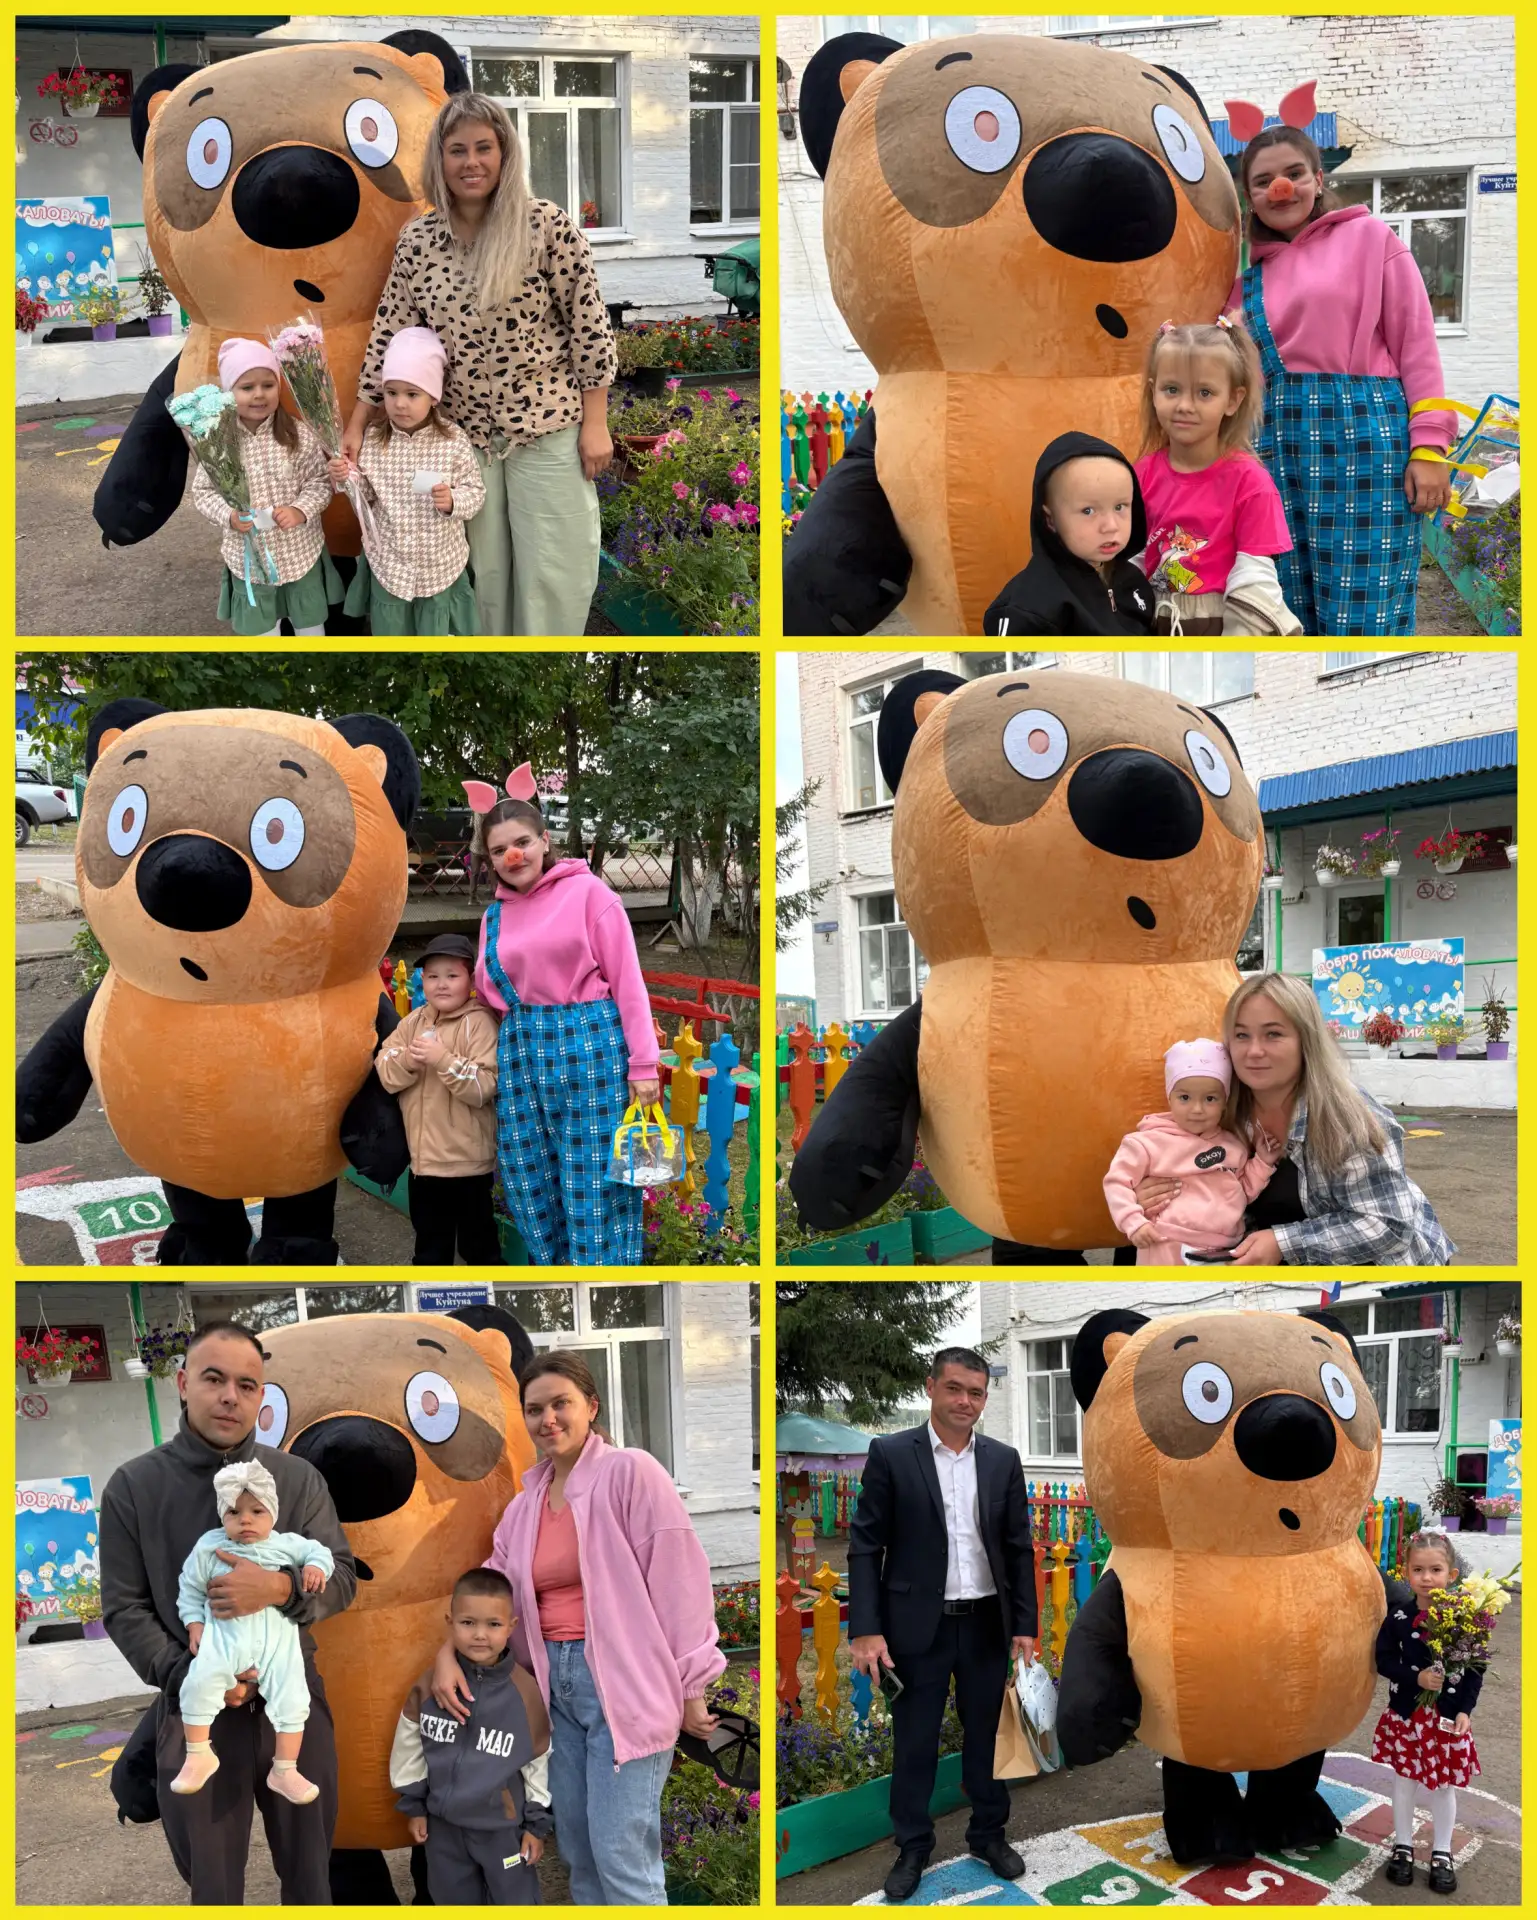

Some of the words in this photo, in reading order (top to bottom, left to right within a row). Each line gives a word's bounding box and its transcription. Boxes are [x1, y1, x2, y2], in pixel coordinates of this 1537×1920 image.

[1316, 952, 1358, 976] ДОБРО
[1362, 947, 1460, 967] ПОЖАЛОВАТЬ!
[1200, 1150, 1222, 1163] okay
[98, 1201, 161, 1230] 10
[420, 1291, 444, 1299] Лучшее
[446, 1290, 486, 1299] учреждение
[435, 1298, 472, 1308] Куйтуна
[420, 1712, 458, 1743] KEKE
[476, 1726, 514, 1758] MAO
